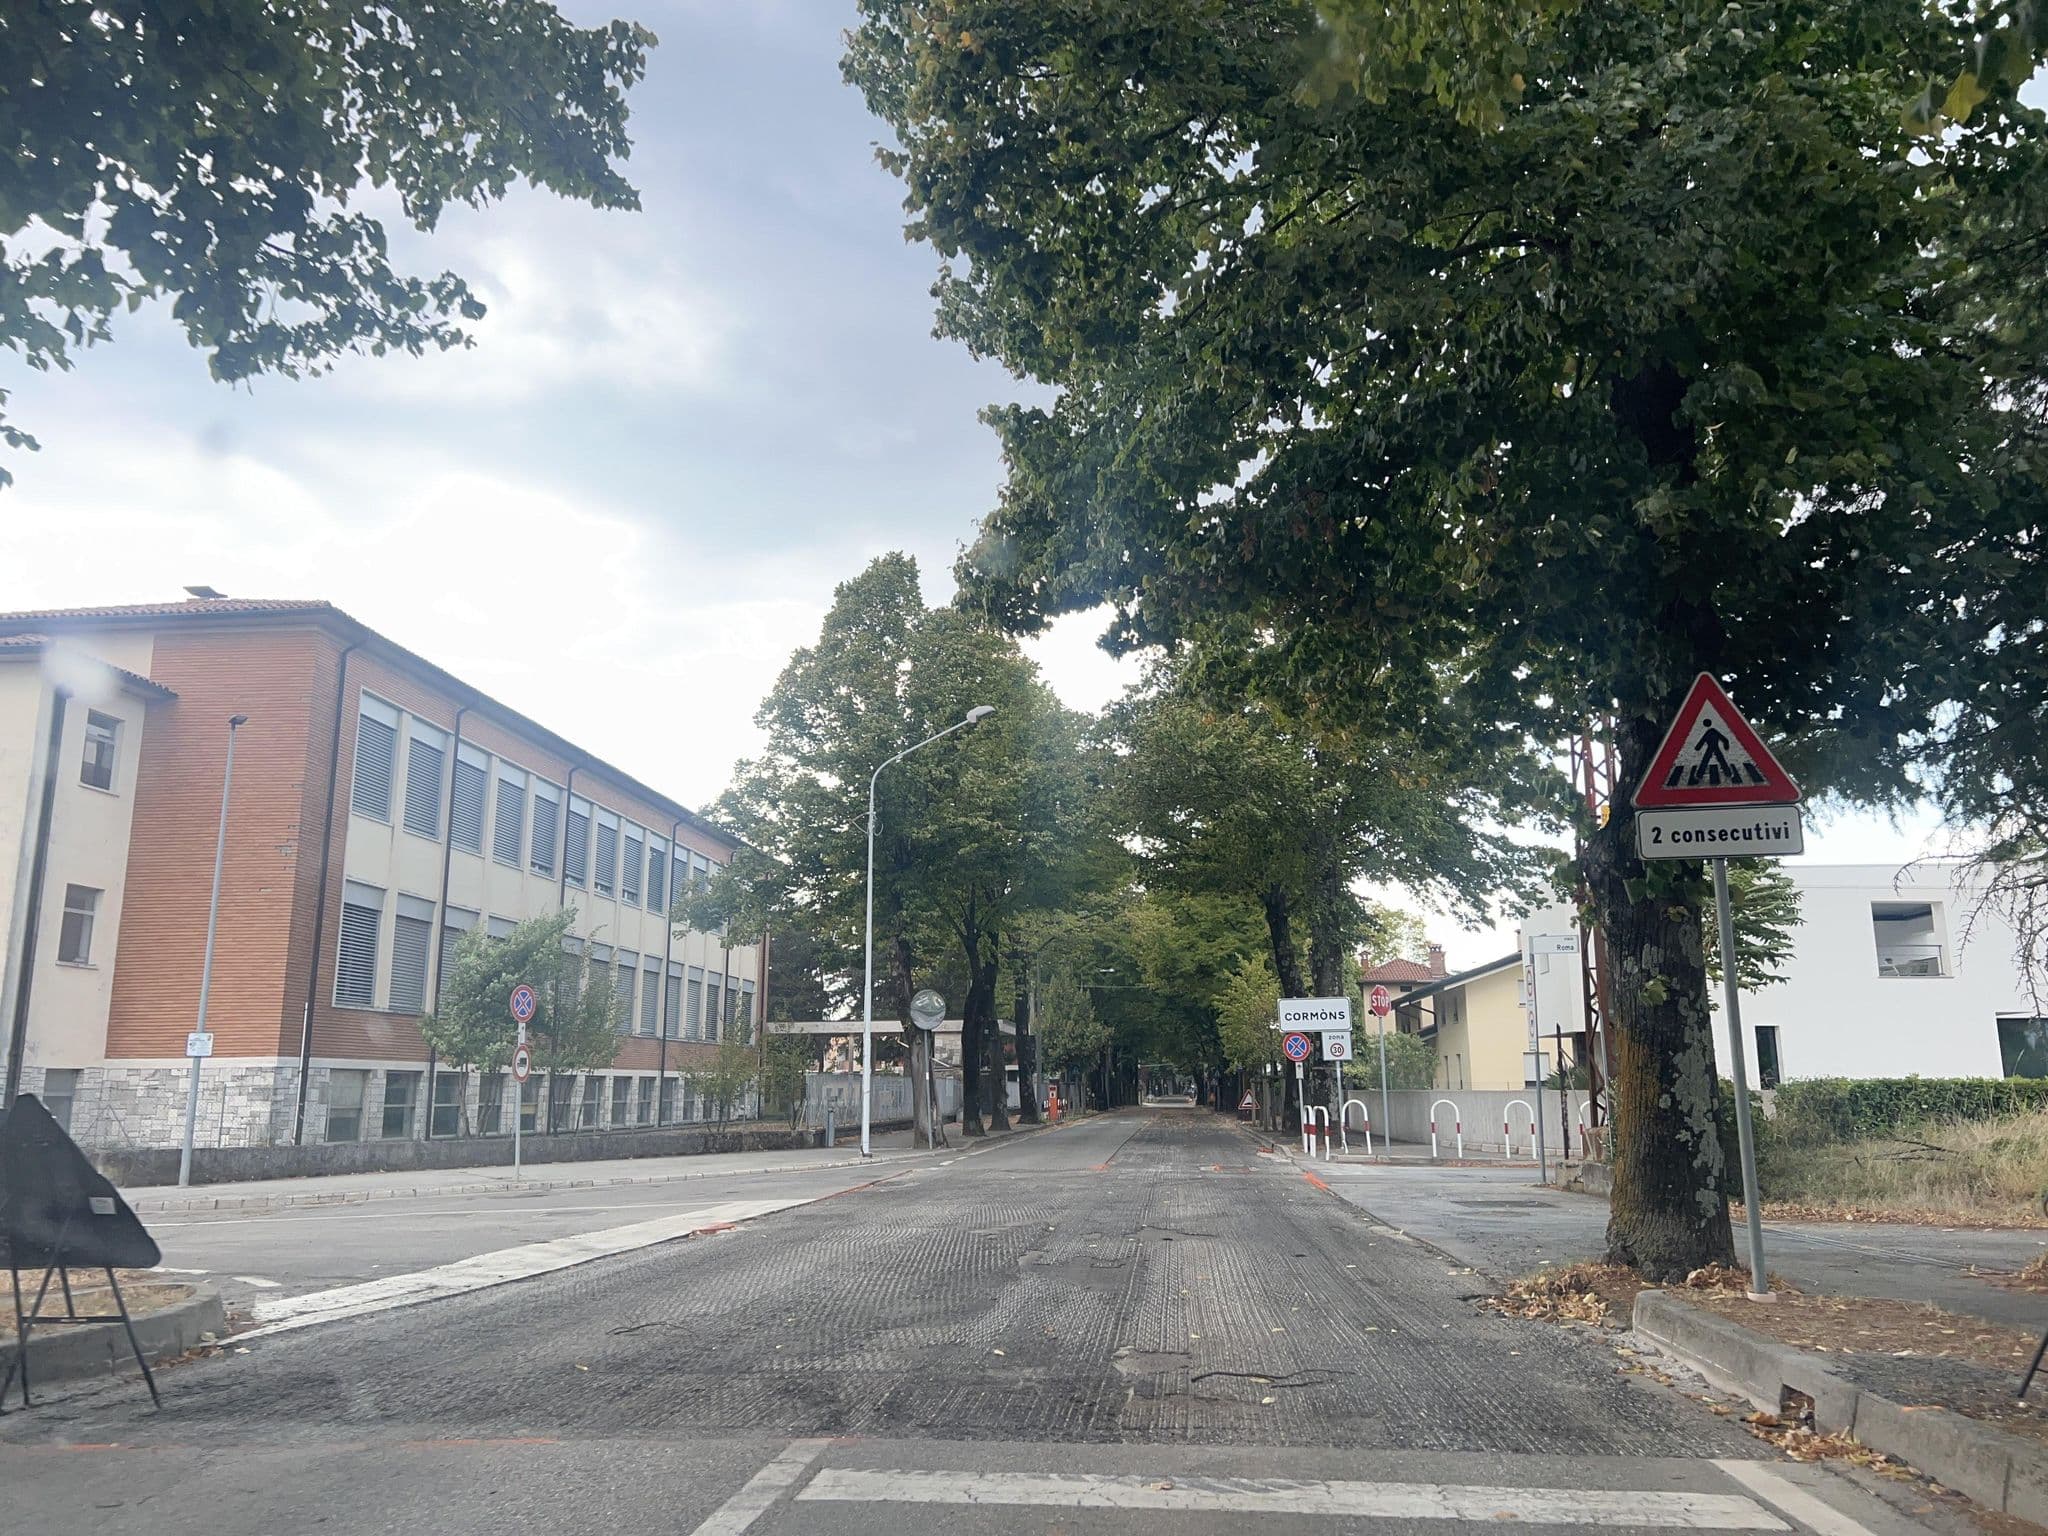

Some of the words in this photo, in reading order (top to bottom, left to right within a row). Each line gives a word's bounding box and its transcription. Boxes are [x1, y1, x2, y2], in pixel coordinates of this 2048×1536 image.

[1651, 826, 1662, 844] 2
[1671, 821, 1790, 843] consecutivi
[1372, 995, 1389, 1007] STOP
[1284, 1009, 1345, 1021] CORMÒNS
[1333, 1046, 1342, 1054] 30
